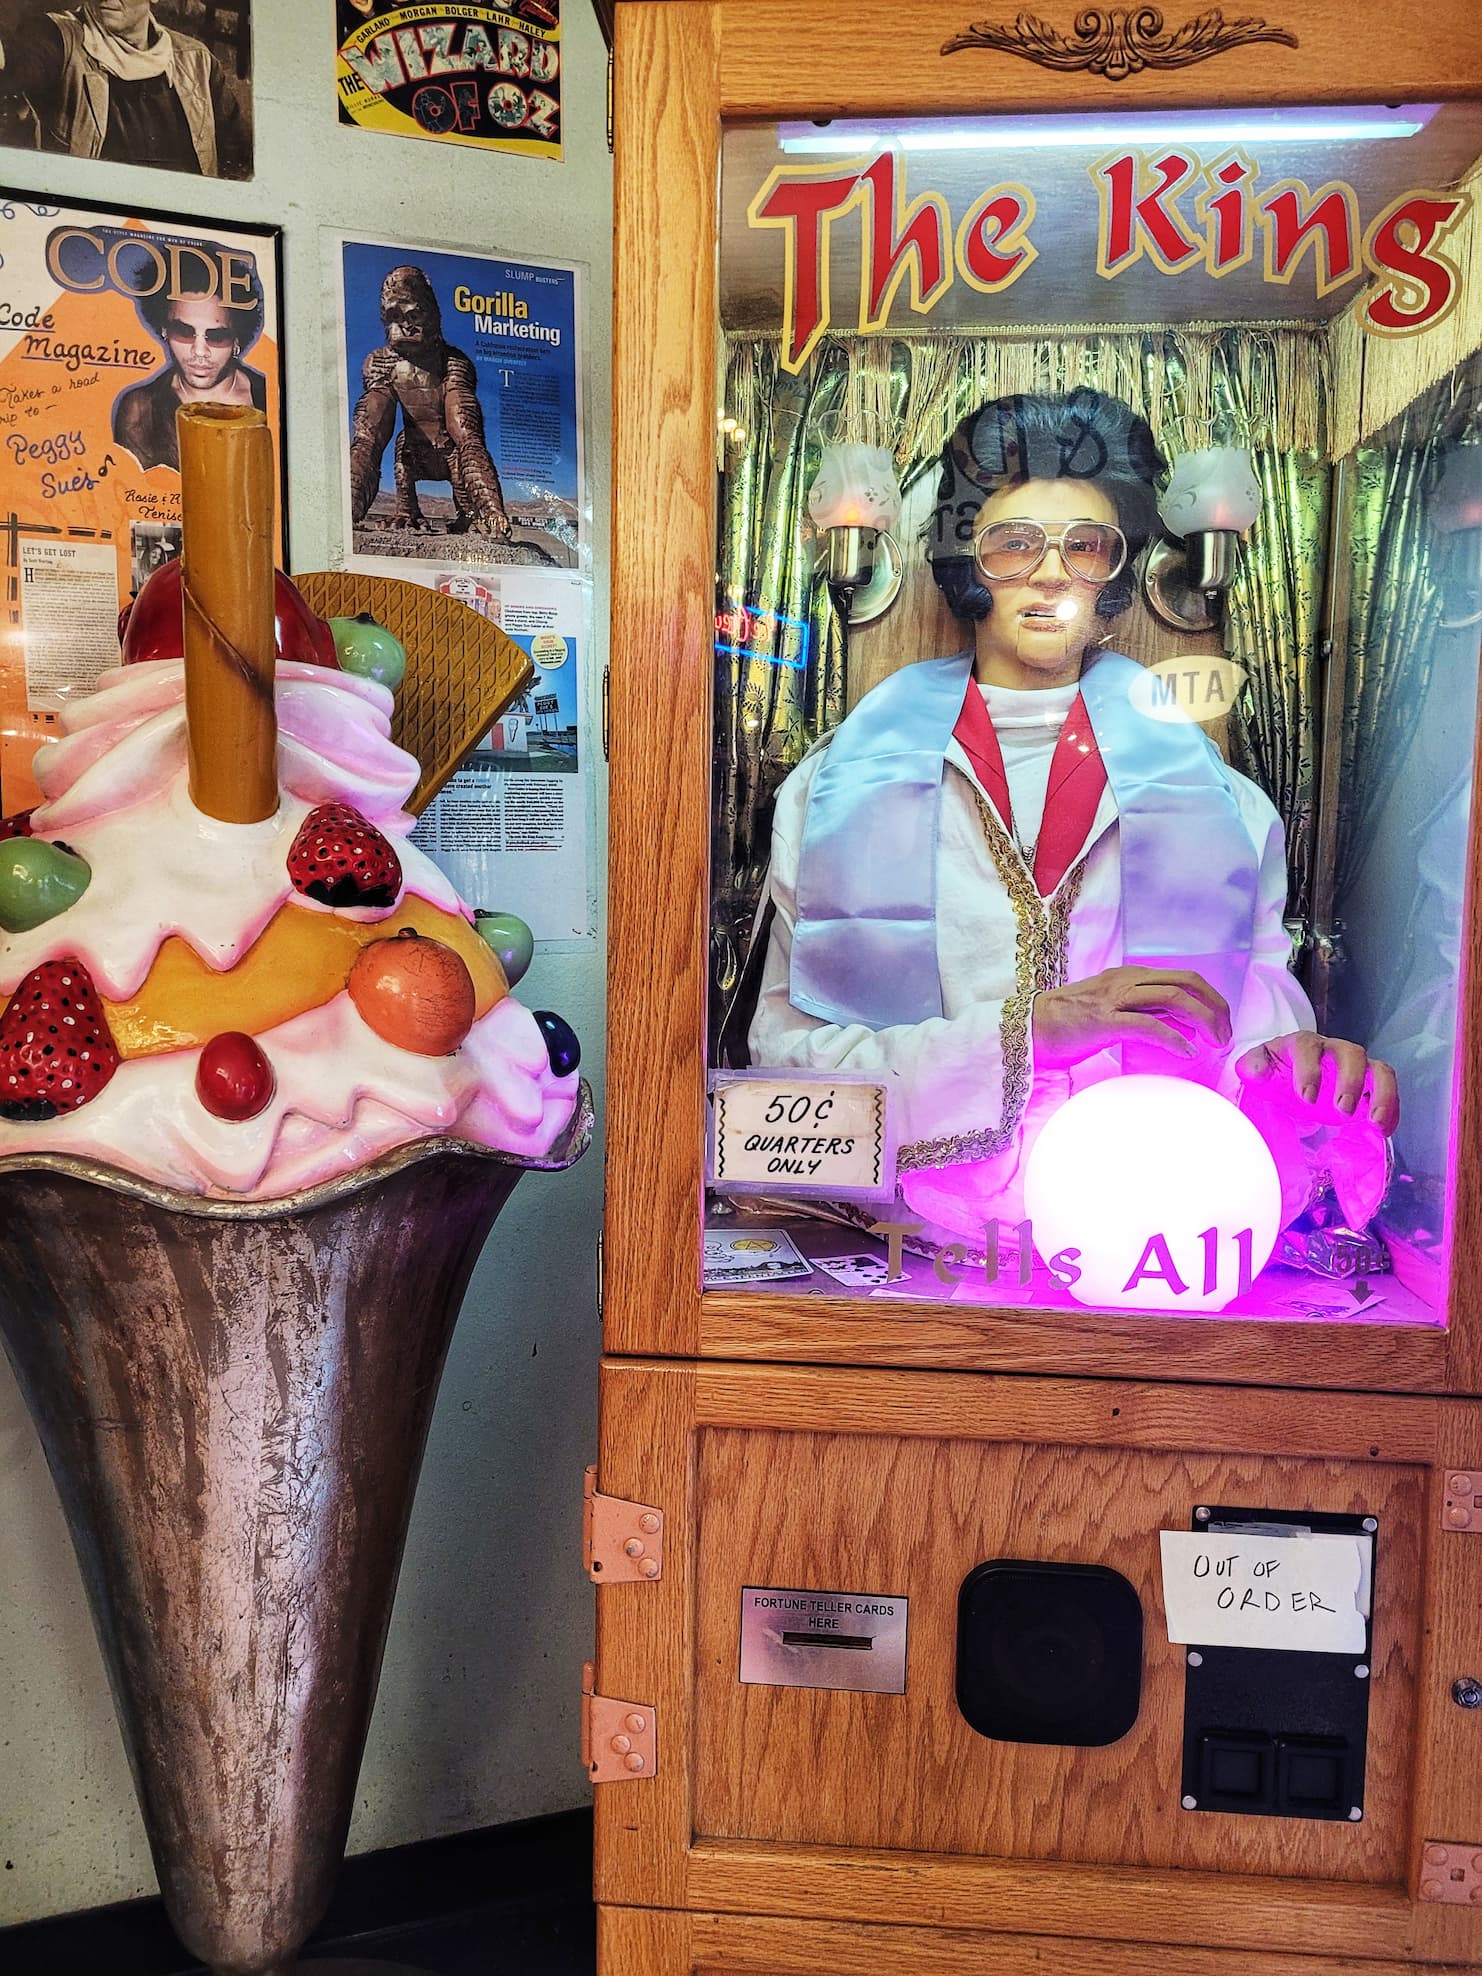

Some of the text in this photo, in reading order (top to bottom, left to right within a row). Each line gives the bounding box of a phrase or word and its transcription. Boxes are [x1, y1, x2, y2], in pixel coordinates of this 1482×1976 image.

[357, 18, 390, 43] GARLAND
[400, 6, 437, 21] MORGAN
[445, 6, 478, 17] BOLGER
[486, 11, 511, 25] LAHR
[518, 21, 546, 38] HALEY
[338, 22, 560, 96] THE WIZARD
[412, 81, 560, 138] OF OZ
[49, 230, 258, 311] CODE
[748, 136, 1475, 375] The King
[505, 269, 534, 281] SLUMP
[0, 303, 55, 329] Code
[454, 286, 528, 319] Gorilla
[474, 314, 561, 347] Marketing
[25, 335, 156, 371] Magazine
[0, 372, 100, 409] Takes a road
[0, 407, 40, 428] rip to
[6, 430, 86, 466] Peggy
[41, 467, 100, 499] Sue's
[125, 489, 159, 503] Rosie
[23, 547, 76, 557] LET'S GET LOST
[765, 1090, 835, 1129] 50¢
[744, 1135, 855, 1155] QUARTERS
[767, 1157, 823, 1175] ONLY
[867, 1217, 1253, 1296] Tells All
[1193, 1555, 1281, 1578] OUT OF
[754, 1597, 894, 1616] FORTUNE TELLER CARDS
[1217, 1587, 1337, 1613] ORDER
[808, 1617, 839, 1629] HERE
